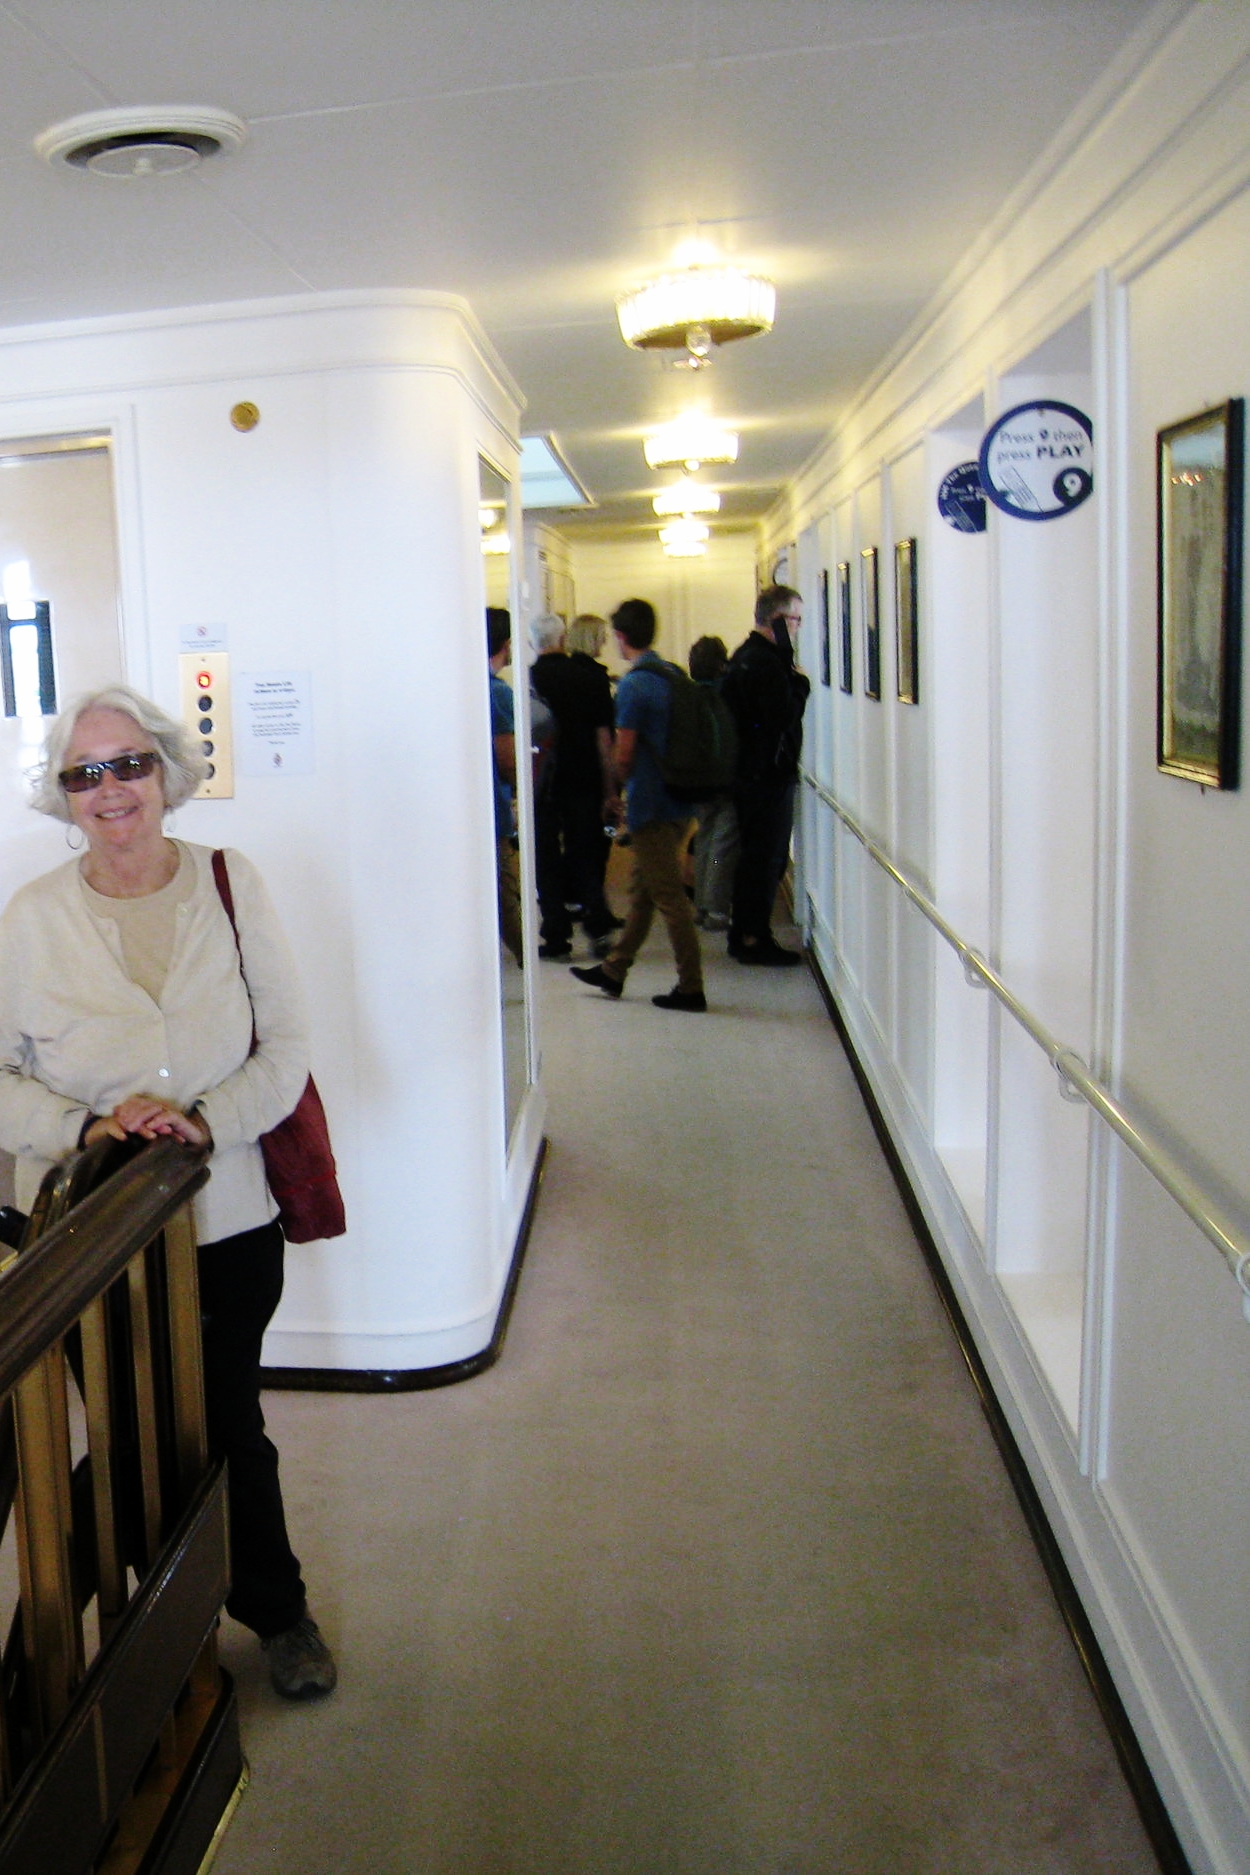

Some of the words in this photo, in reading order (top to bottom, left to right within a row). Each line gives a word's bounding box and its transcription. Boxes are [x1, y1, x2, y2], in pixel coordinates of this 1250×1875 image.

[999, 430, 1035, 444] Press
[1053, 428, 1083, 443] then
[997, 449, 1032, 465] press
[1036, 444, 1086, 460] PLAY
[1062, 472, 1083, 498] 9
